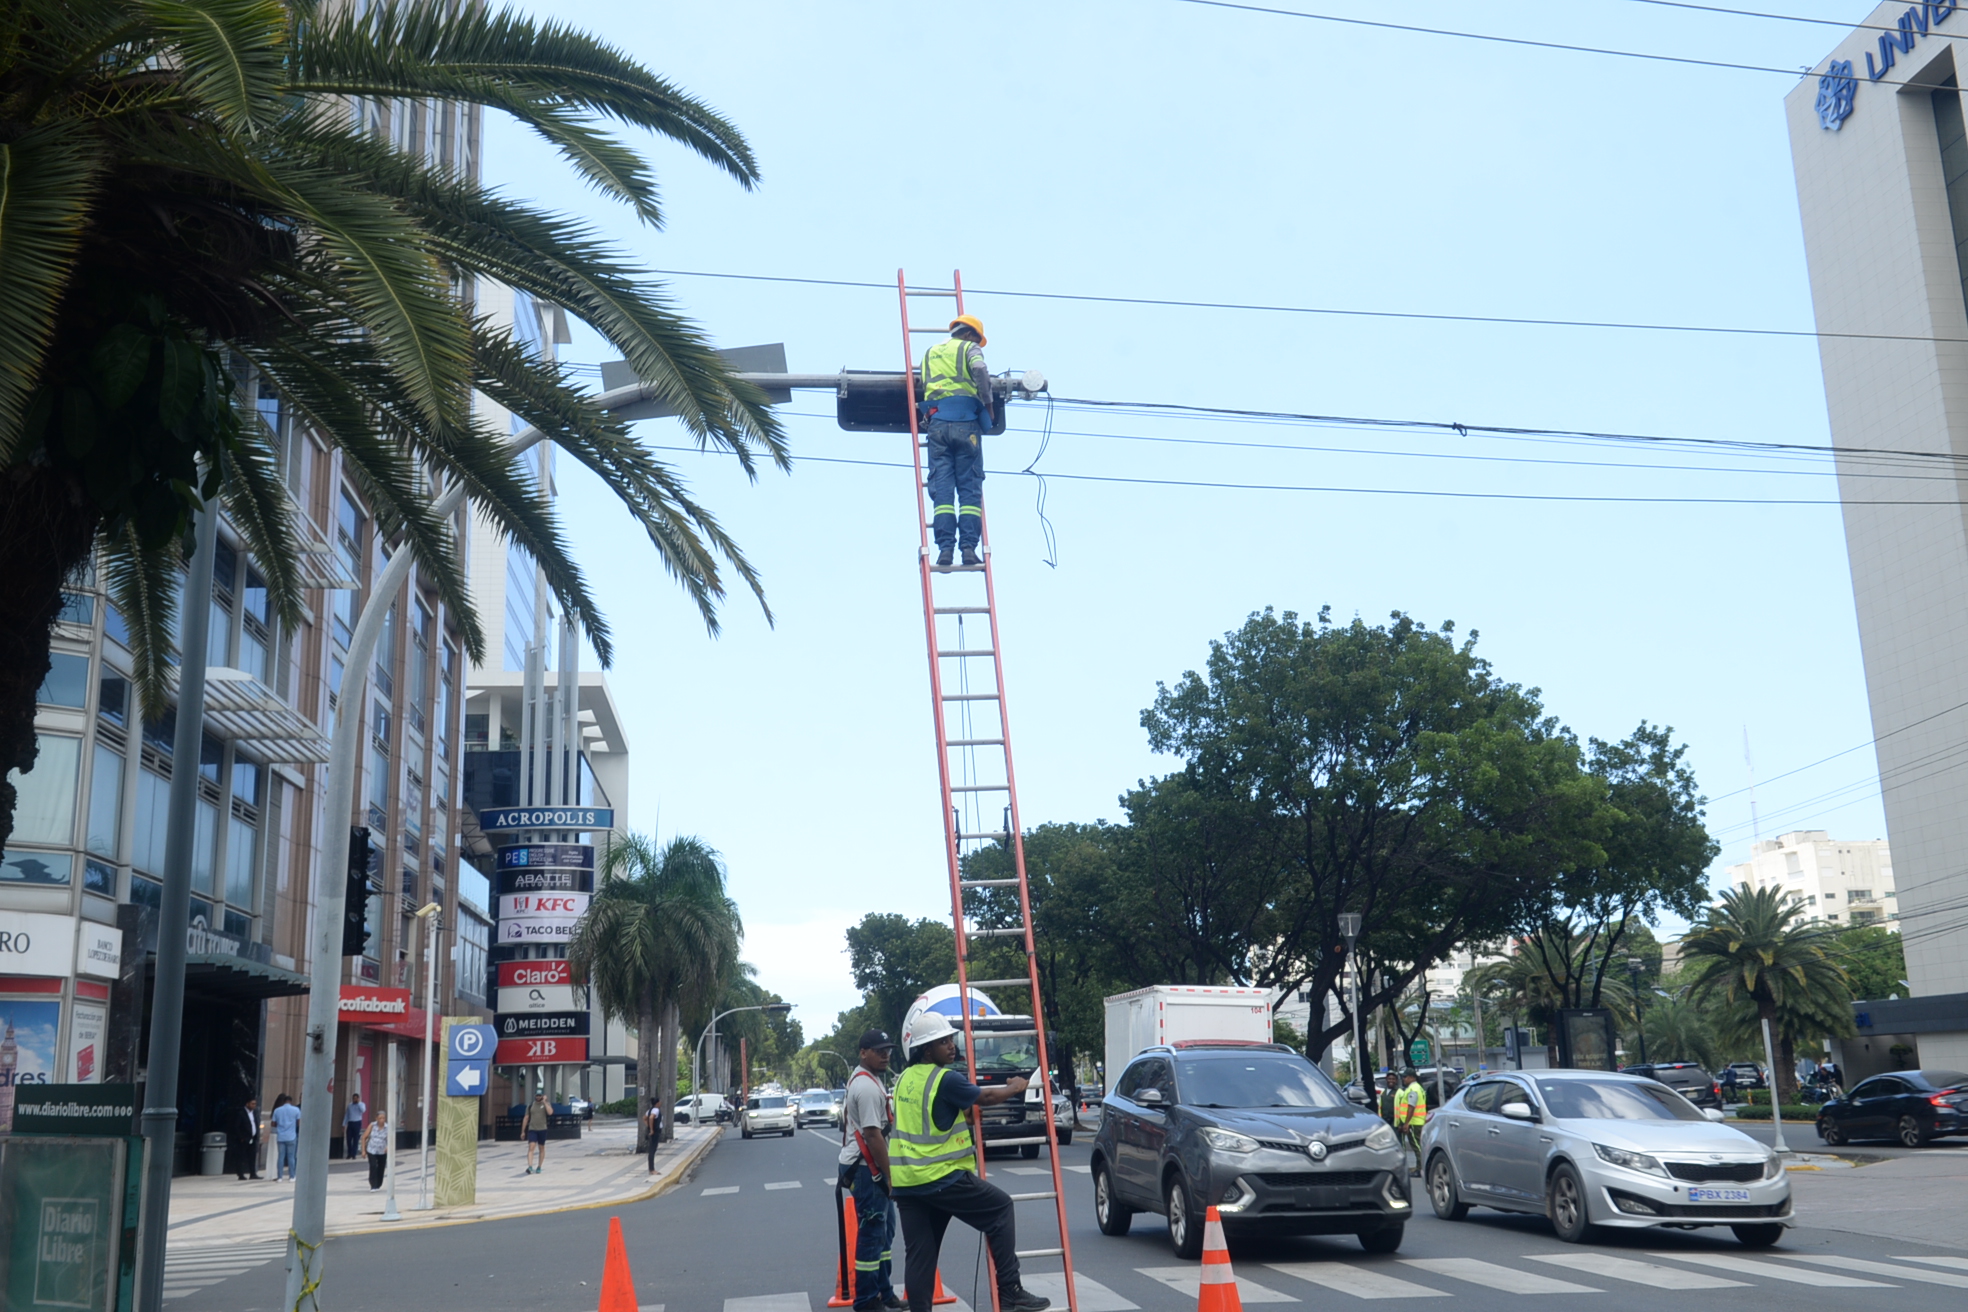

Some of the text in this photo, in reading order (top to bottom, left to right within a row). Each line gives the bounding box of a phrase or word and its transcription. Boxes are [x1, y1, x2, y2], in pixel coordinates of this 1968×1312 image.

[1865, 0, 1957, 82] UNIVE
[496, 811, 595, 826] ACROPOLIS
[505, 851, 528, 864] PES
[515, 874, 572, 883] ABATTE
[535, 898, 576, 911] KFC
[525, 926, 553, 935] TACO
[97, 938, 114, 952] BANCO
[514, 967, 561, 984] Claro
[338, 996, 406, 1013] cotiabank
[519, 1018, 575, 1029] MEIDDEN
[463, 1034, 477, 1051] P
[18, 1102, 113, 1117] www.diariolibre.com
[1699, 1190, 1748, 1199] PBX 2384
[44, 1206, 92, 1234] Diario
[41, 1236, 84, 1263] Libre
